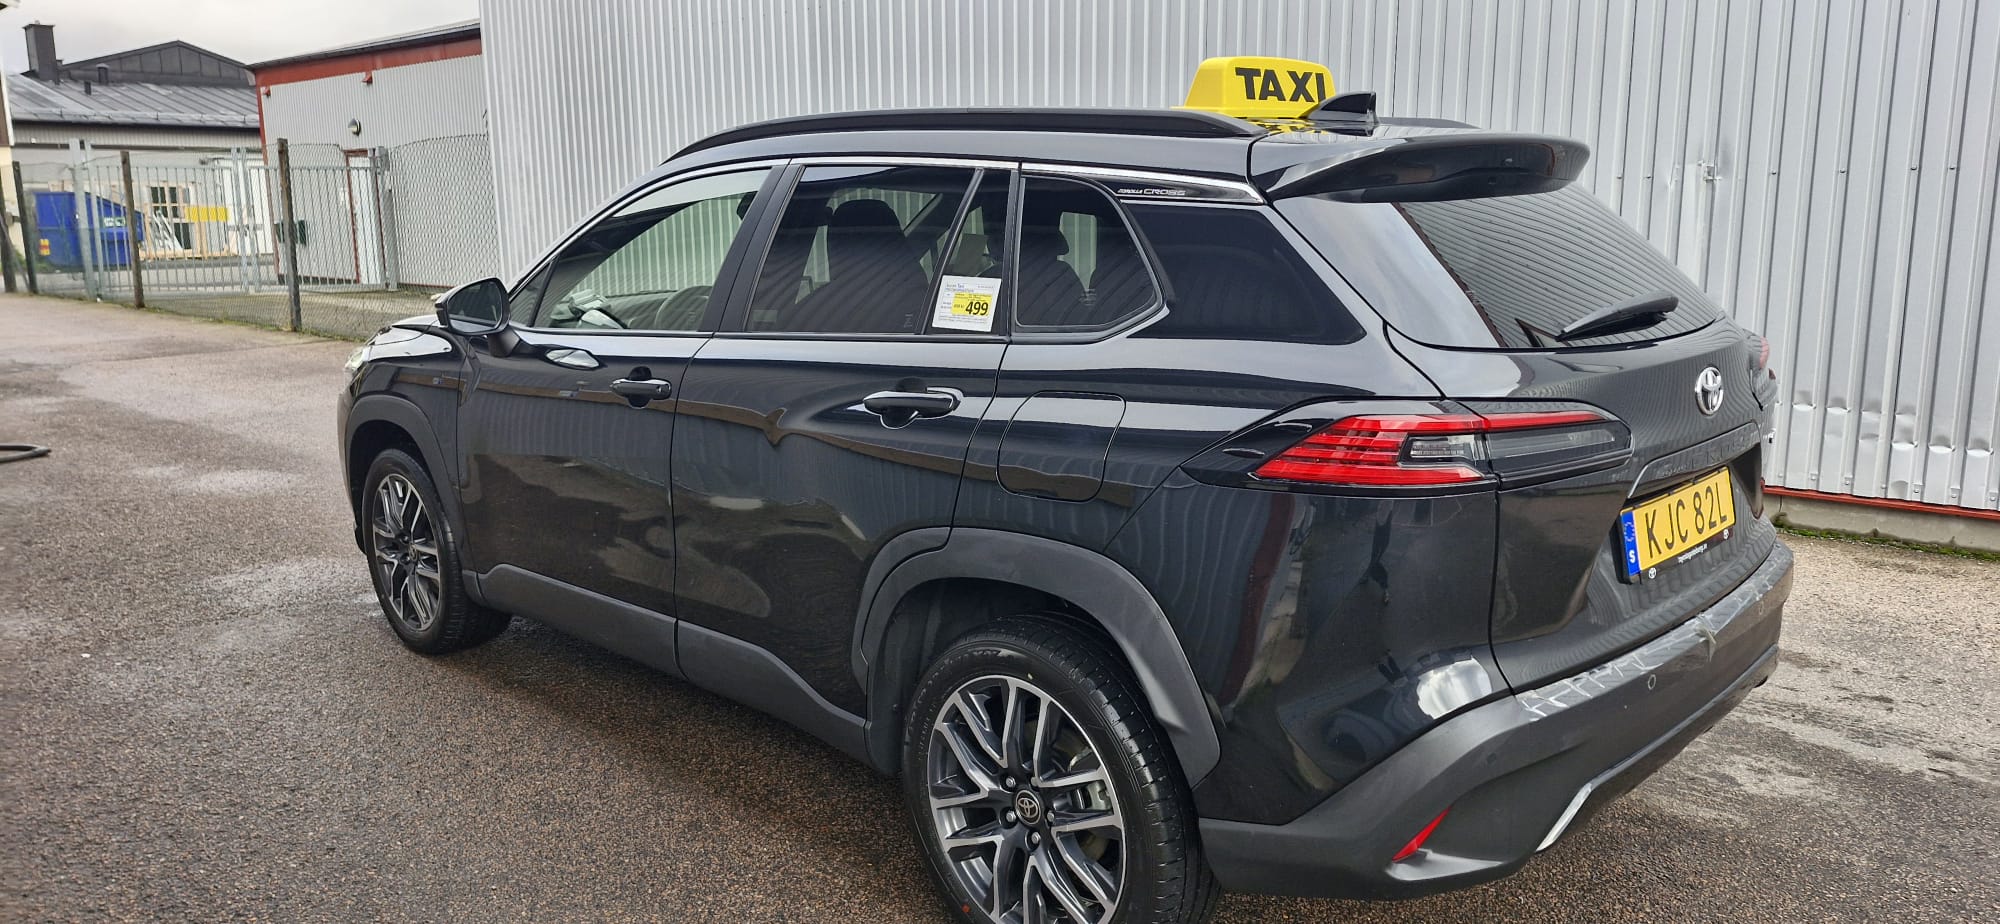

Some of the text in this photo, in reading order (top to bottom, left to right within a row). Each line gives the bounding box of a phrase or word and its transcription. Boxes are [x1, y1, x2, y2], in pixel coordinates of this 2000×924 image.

[1235, 67, 1326, 103] TAXI
[1143, 188, 1187, 196] CROSS
[1644, 482, 1728, 559] KJC 82L
[1628, 550, 1636, 564] S
